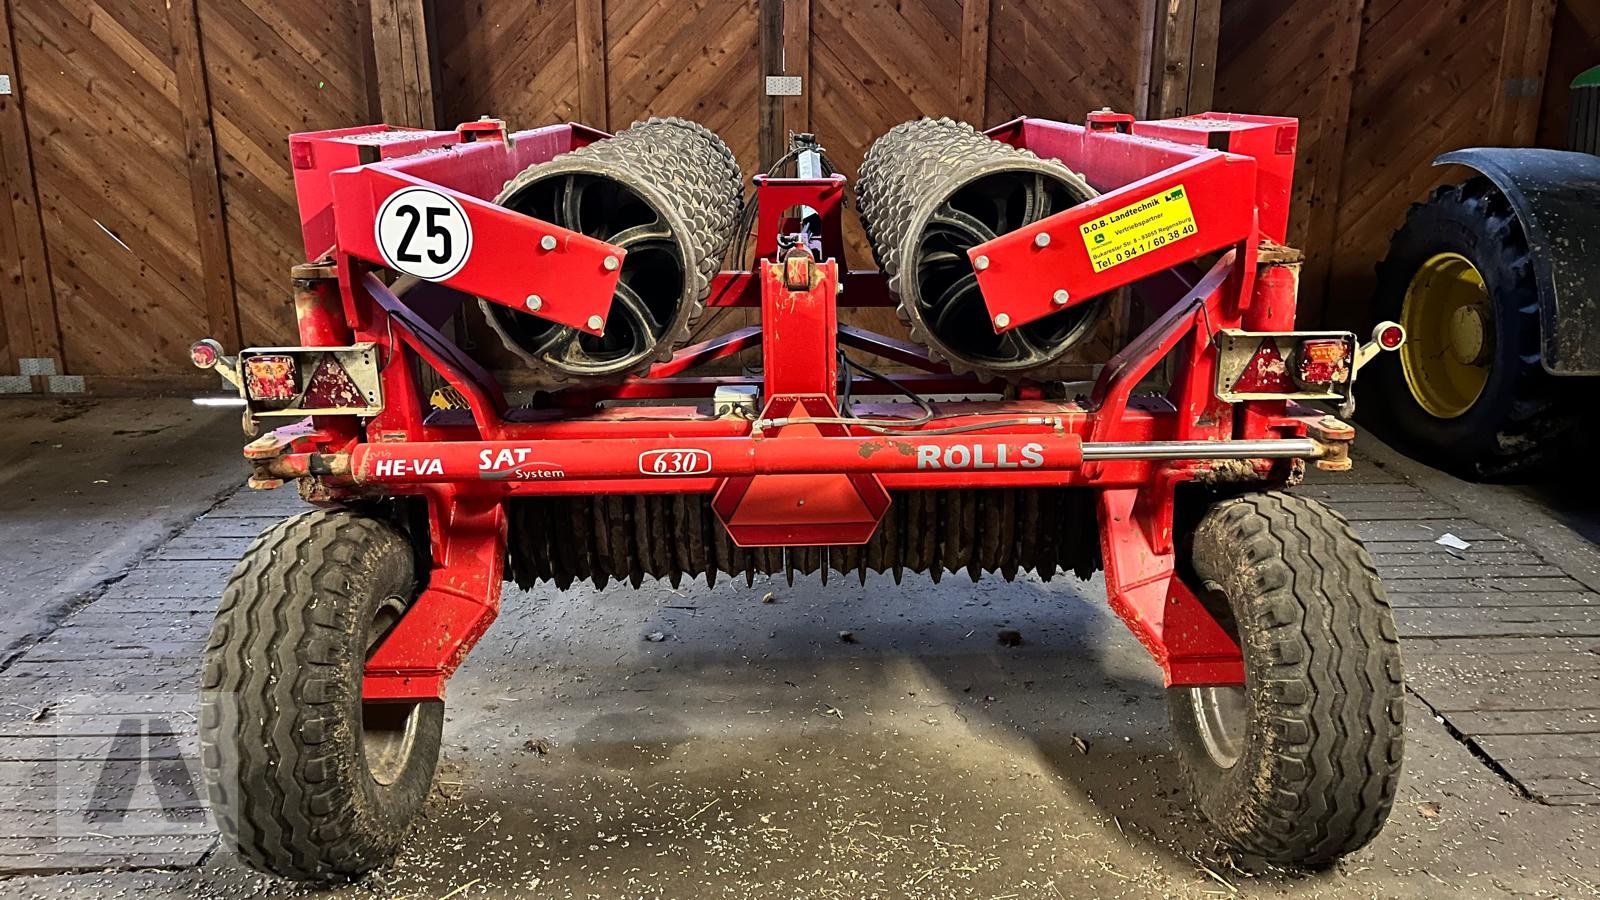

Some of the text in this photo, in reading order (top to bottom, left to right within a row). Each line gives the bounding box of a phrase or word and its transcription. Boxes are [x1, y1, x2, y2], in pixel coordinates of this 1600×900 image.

[1083, 199, 1160, 234] D.O.B. Landtechnik
[1115, 213, 1163, 235] Vertriebspartner
[396, 204, 452, 265] 25
[1093, 245, 1122, 259] Bukarester
[1158, 217, 1191, 232] Regensburg
[1096, 257, 1114, 269] Tel.
[1116, 253, 1122, 261] 0
[1124, 247, 1136, 258] 94
[1153, 235, 1165, 246] 60
[1168, 230, 1179, 240] 38
[1182, 224, 1194, 235] 40
[376, 458, 444, 476] HE-VA
[479, 448, 532, 470] SAT
[653, 452, 697, 473] 630
[917, 442, 1045, 470] ROLLS
[515, 469, 565, 479] System
